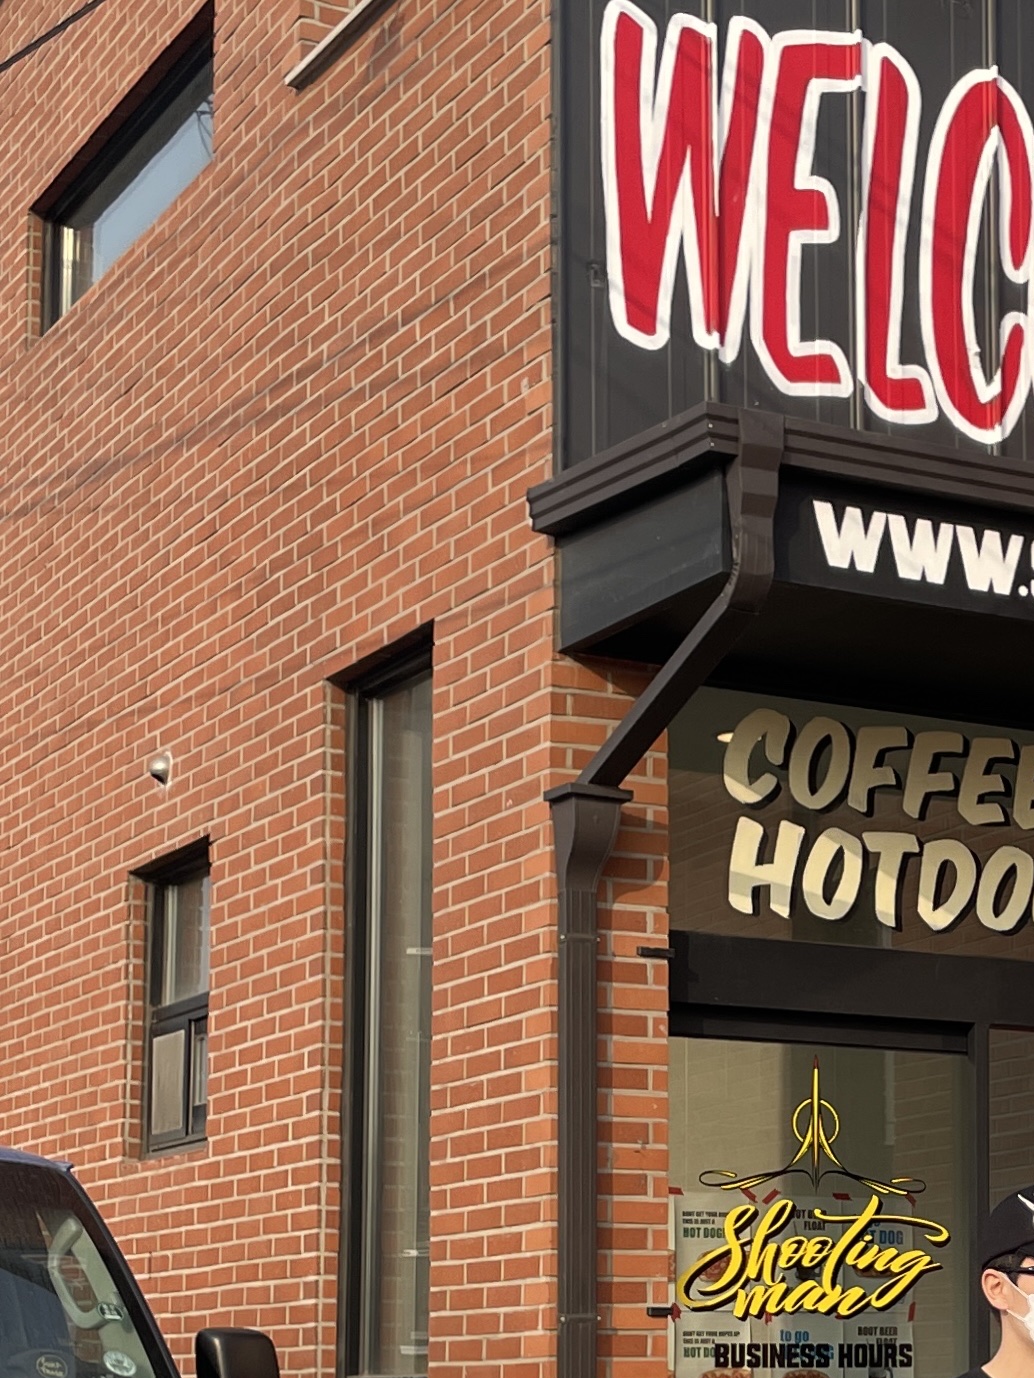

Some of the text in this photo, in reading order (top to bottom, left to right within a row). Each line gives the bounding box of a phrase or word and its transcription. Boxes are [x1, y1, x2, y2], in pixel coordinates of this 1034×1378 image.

[683, 1227, 701, 1238] HOT
[880, 1231, 903, 1244] DOG
[677, 1194, 950, 1310] Shooting
[733, 1278, 870, 1320] man
[684, 1347, 701, 1358] HOT
[714, 1342, 830, 1368] BUSINESS
[838, 1342, 913, 1368] HOURS
